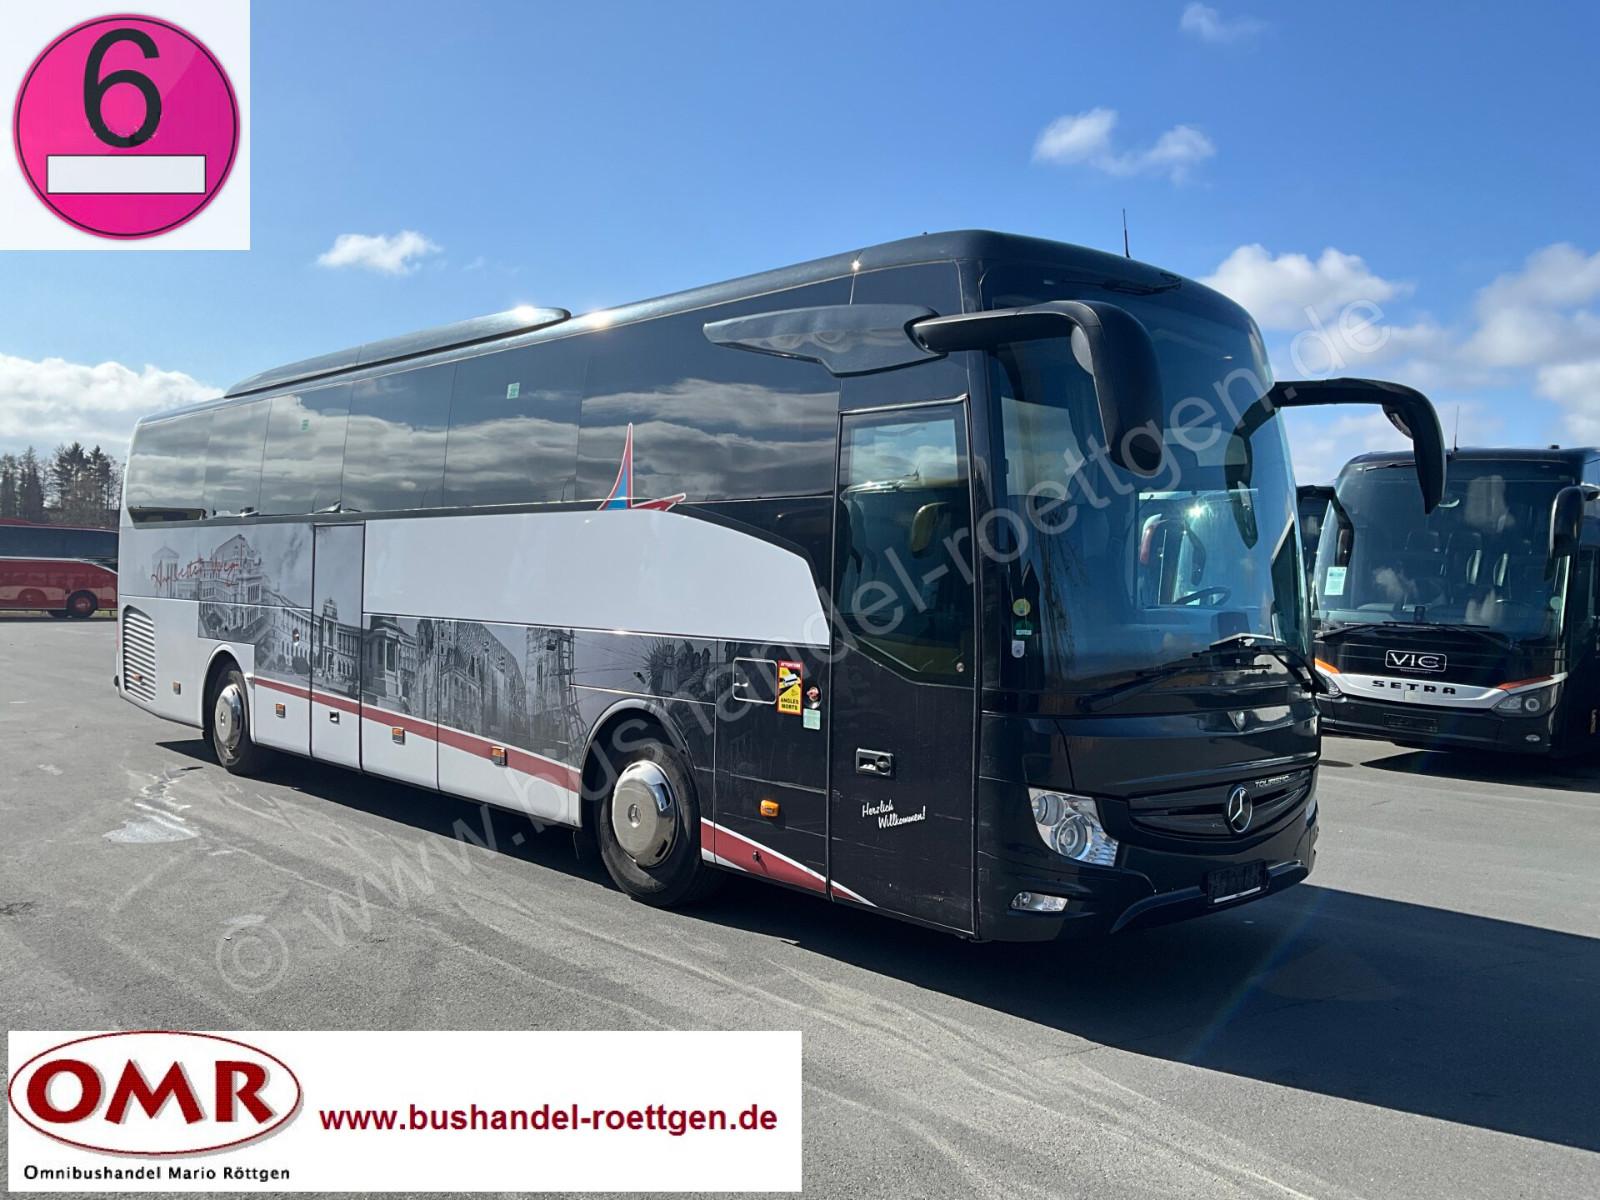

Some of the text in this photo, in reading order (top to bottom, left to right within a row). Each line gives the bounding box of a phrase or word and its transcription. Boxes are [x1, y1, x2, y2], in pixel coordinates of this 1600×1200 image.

[1372, 679, 1456, 695] SETRA
[862, 799, 894, 818] Herzlich
[878, 804, 926, 829] Willkommen!
